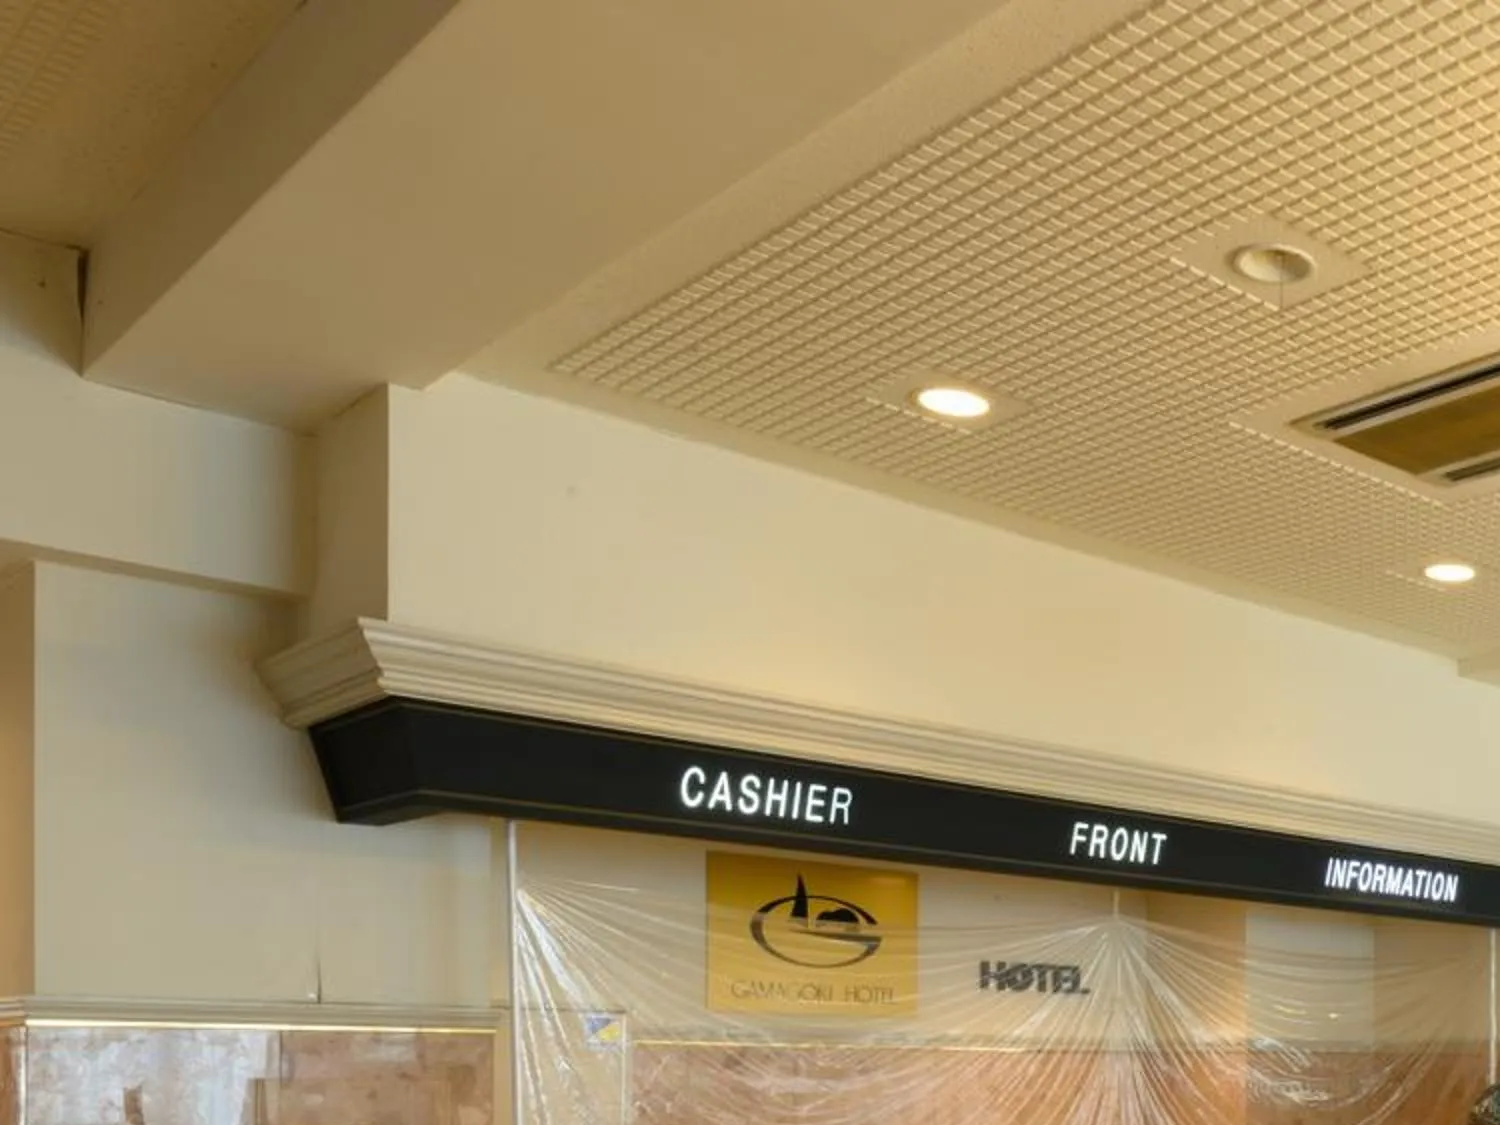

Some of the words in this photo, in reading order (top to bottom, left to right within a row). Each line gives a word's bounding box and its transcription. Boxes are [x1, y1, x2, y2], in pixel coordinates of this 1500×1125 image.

[681, 765, 853, 826] CASHIER
[1069, 821, 1168, 865] FRONT
[1324, 856, 1459, 902] INFORMATION
[844, 983, 898, 1004] HOTEL
[978, 960, 1090, 995] HOTEL
